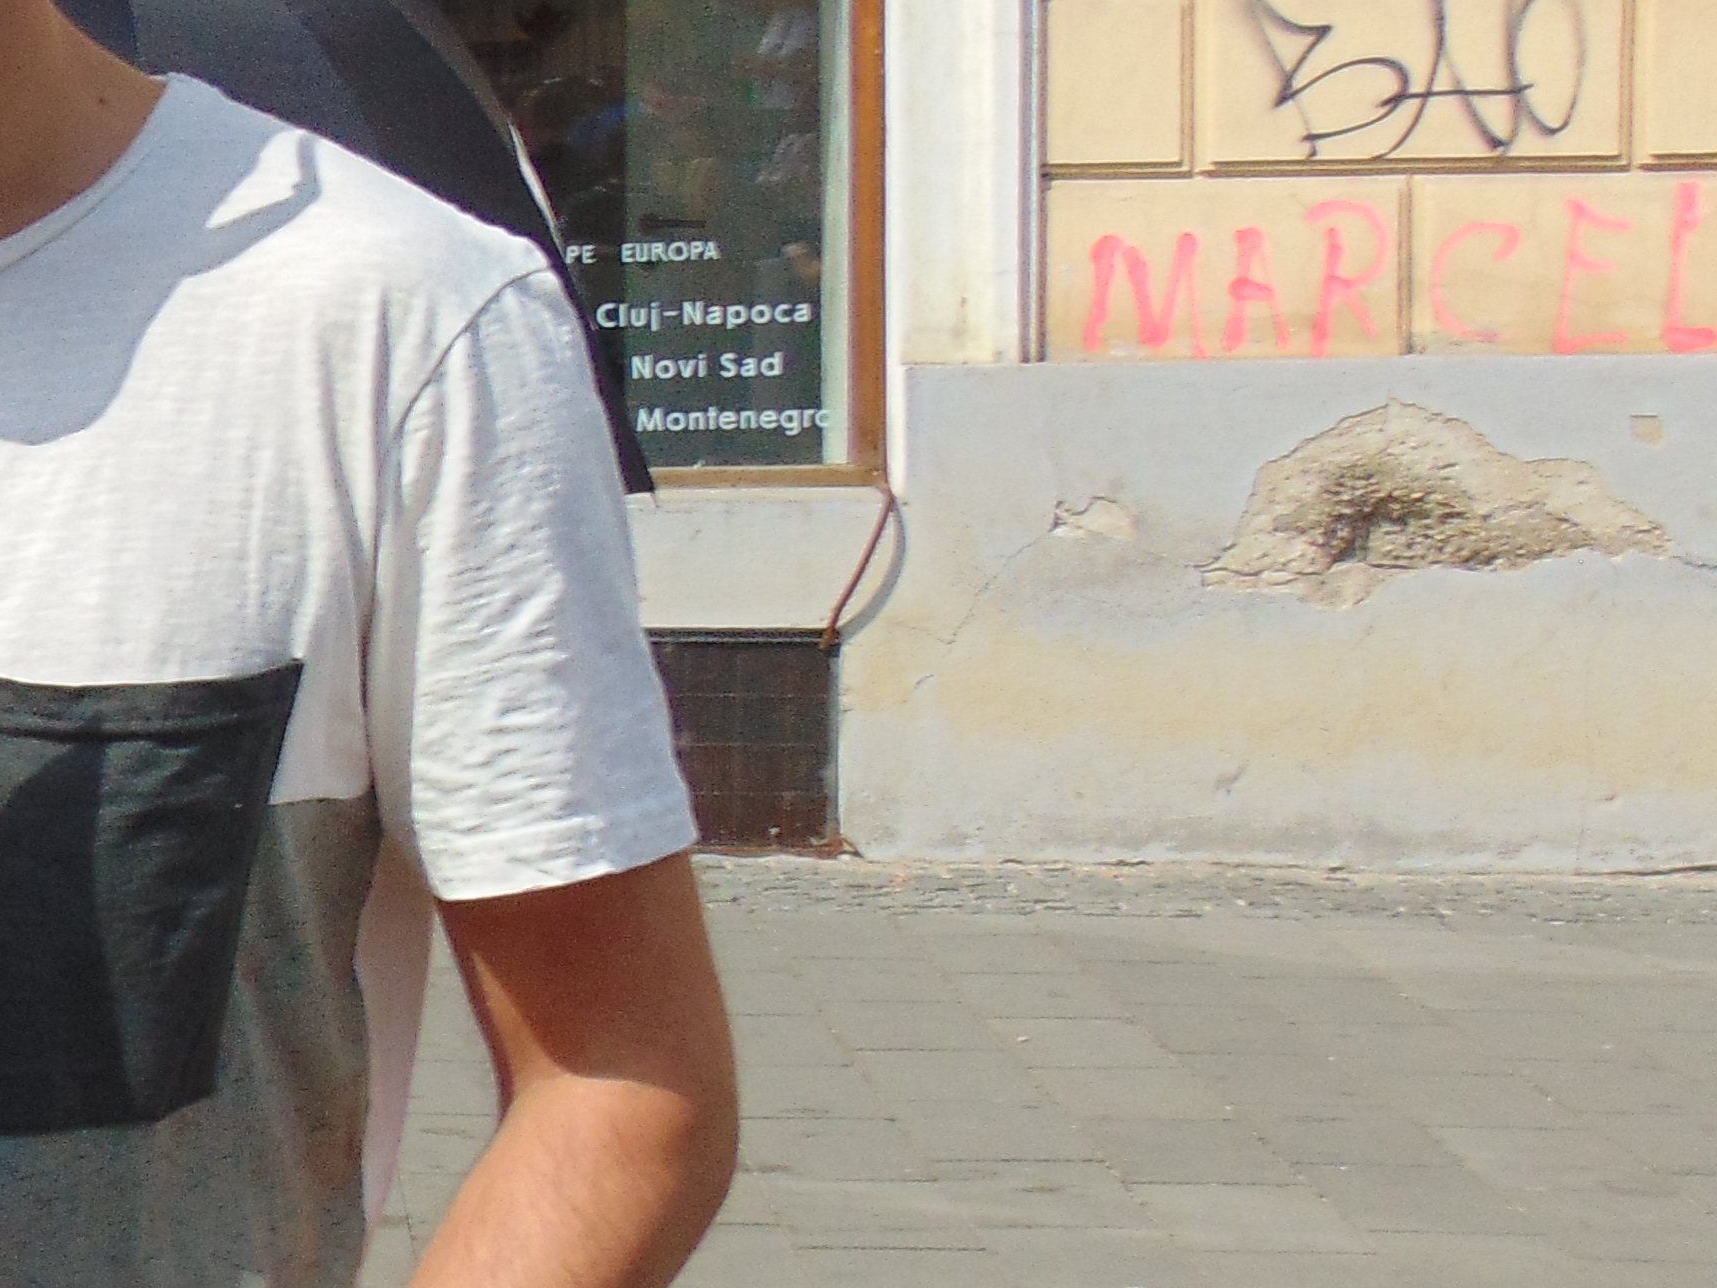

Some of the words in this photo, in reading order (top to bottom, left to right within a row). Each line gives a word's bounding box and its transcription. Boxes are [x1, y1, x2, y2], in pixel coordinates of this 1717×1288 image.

[621, 241, 720, 262] EUROPA
[1083, 181, 1717, 358] MARCEL
[595, 301, 813, 332] Cluj-Napoca
[631, 353, 706, 379] Novi
[719, 351, 783, 377] Sad
